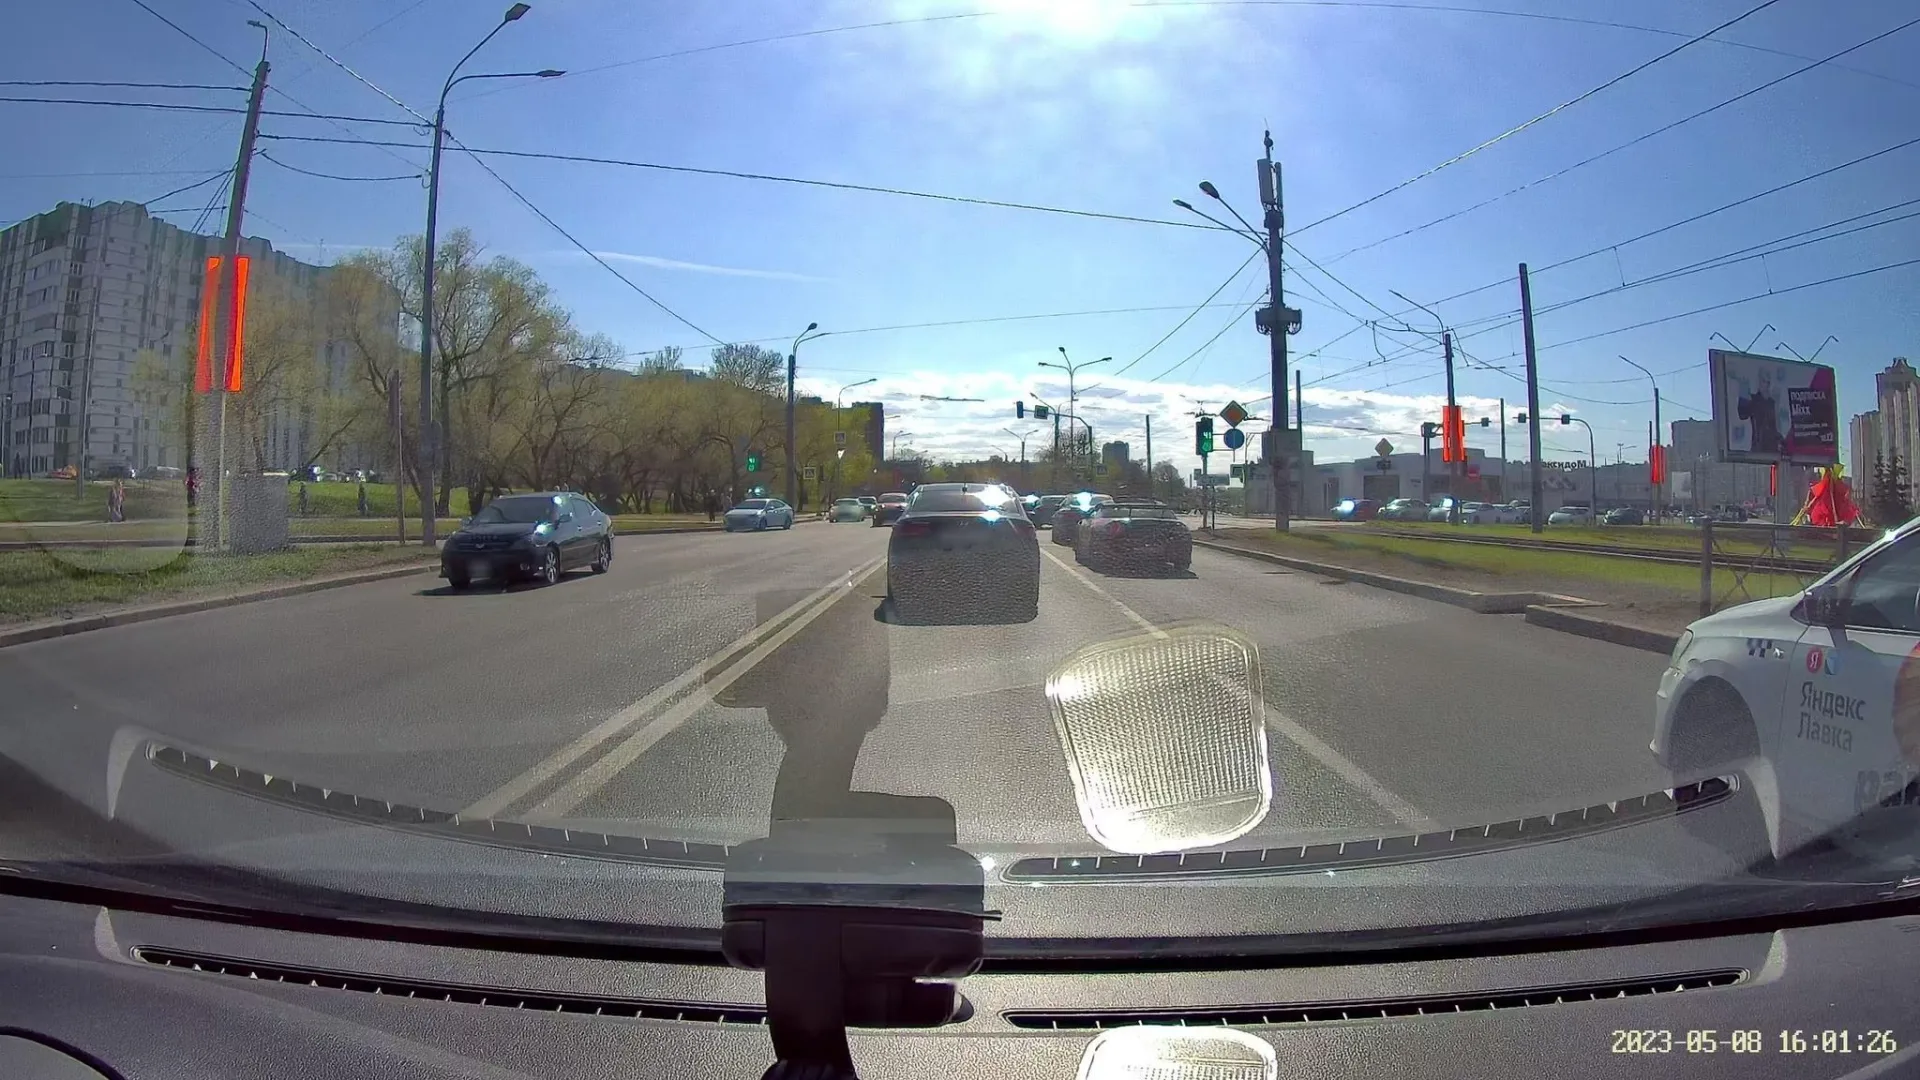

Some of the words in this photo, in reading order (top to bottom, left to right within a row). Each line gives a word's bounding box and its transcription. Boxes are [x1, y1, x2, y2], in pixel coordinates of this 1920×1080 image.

[1790, 391, 1826, 402] ПОДПИСКА
[1541, 459, 1587, 472] аксидоМ
[1809, 651, 1819, 669] Я
[1800, 680, 1867, 721] Яндекс
[1797, 711, 1853, 753] Лавка
